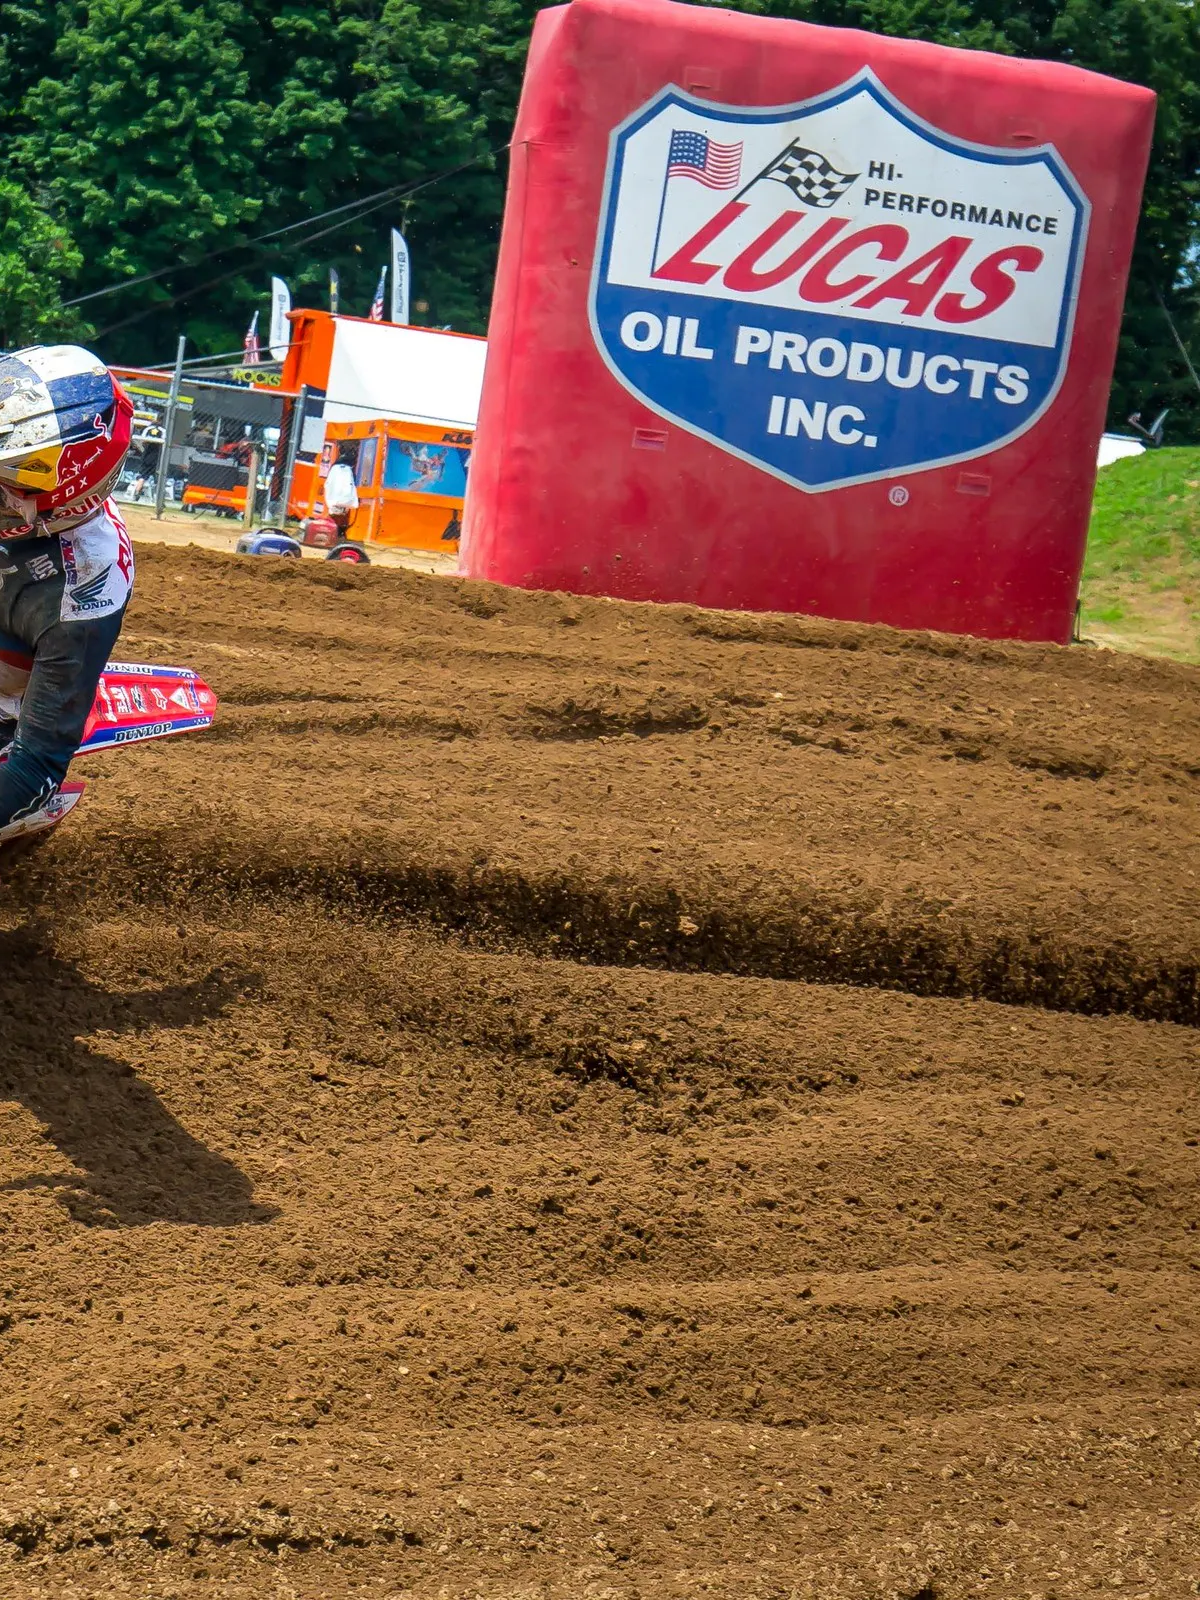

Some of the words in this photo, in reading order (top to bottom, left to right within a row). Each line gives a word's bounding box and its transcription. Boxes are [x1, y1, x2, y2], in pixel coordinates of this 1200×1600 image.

[868, 160, 903, 181] HI-
[864, 187, 1059, 236] PERFORMANCE
[650, 200, 1044, 324] LUCAS
[620, 311, 714, 360] OIL
[734, 325, 1030, 405] PRODUCTS
[766, 395, 878, 448] INC.
[50, 476, 88, 504] FOX
[71, 598, 115, 613] HONDA
[114, 721, 173, 741] DUNLOP
